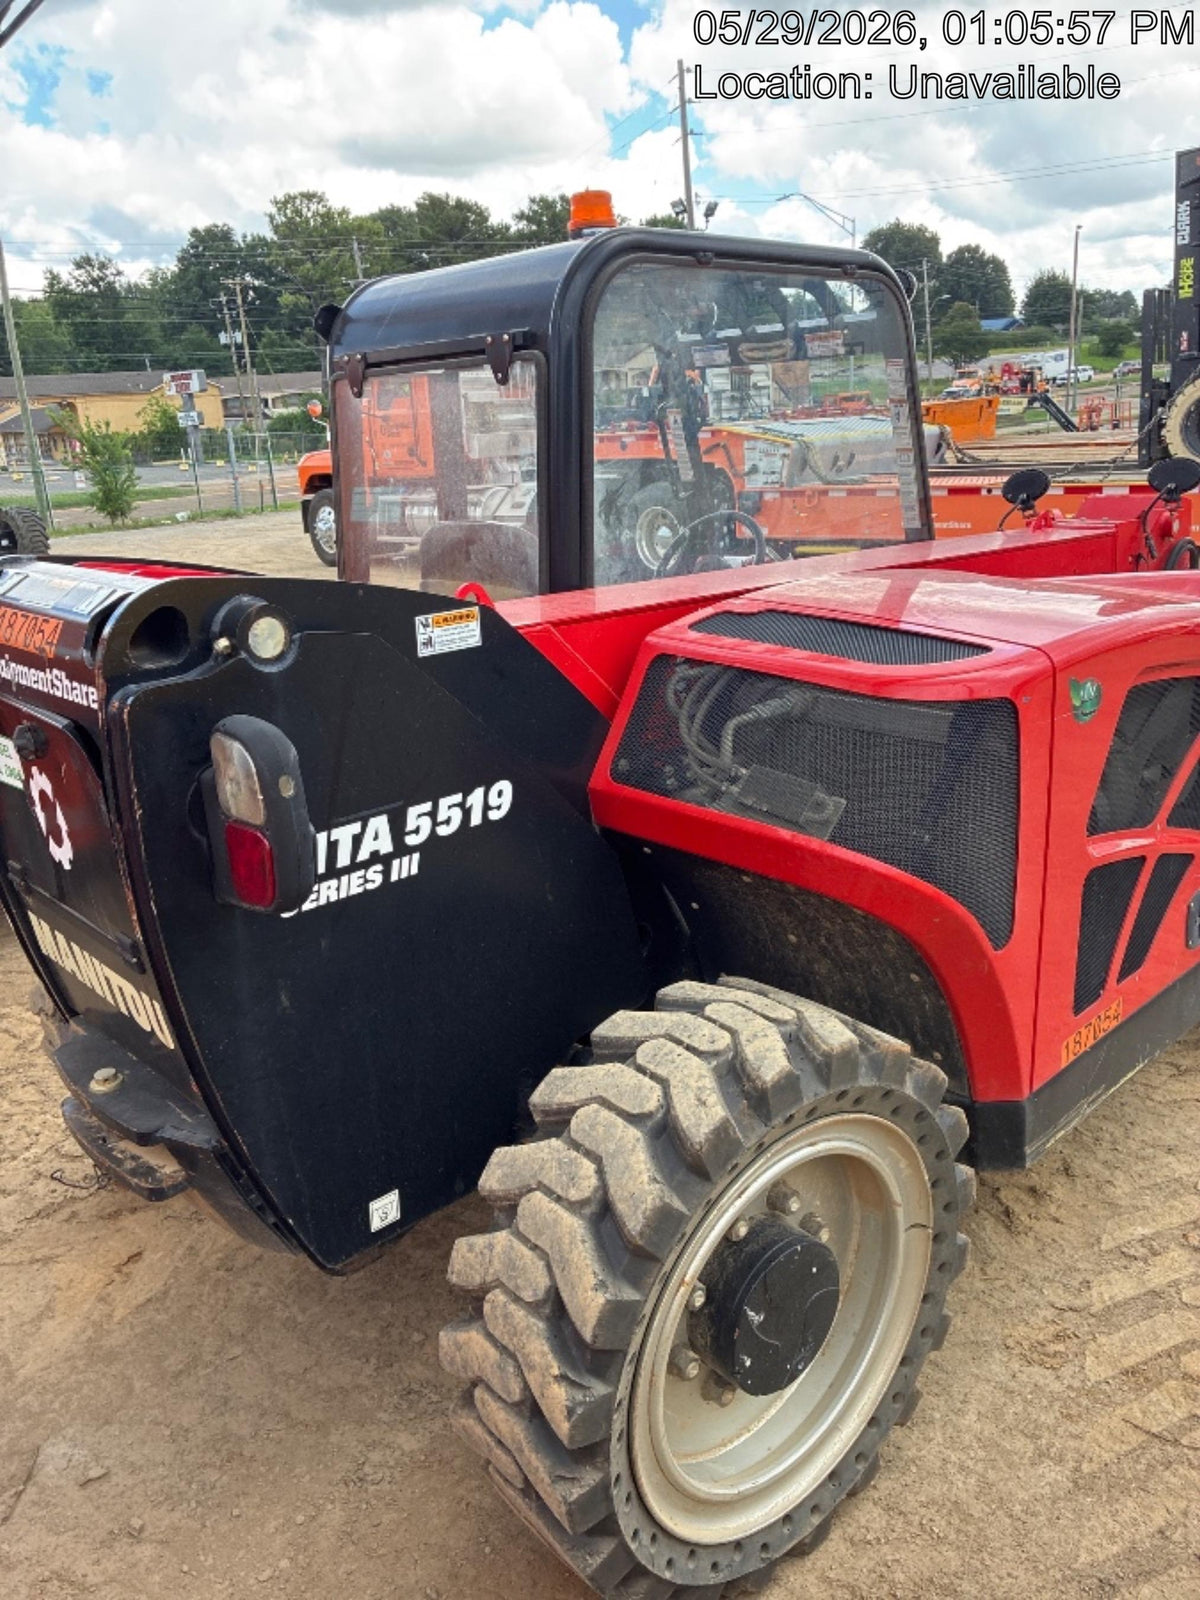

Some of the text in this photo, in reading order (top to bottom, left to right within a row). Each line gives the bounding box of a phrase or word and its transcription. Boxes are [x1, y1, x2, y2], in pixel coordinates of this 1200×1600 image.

[1177, 200, 1190, 246] CLARK
[404, 780, 513, 846] 5519
[280, 852, 420, 918] ERIES III
[27, 911, 175, 1050] MANITOU
[1064, 1000, 1120, 1062] 187054
